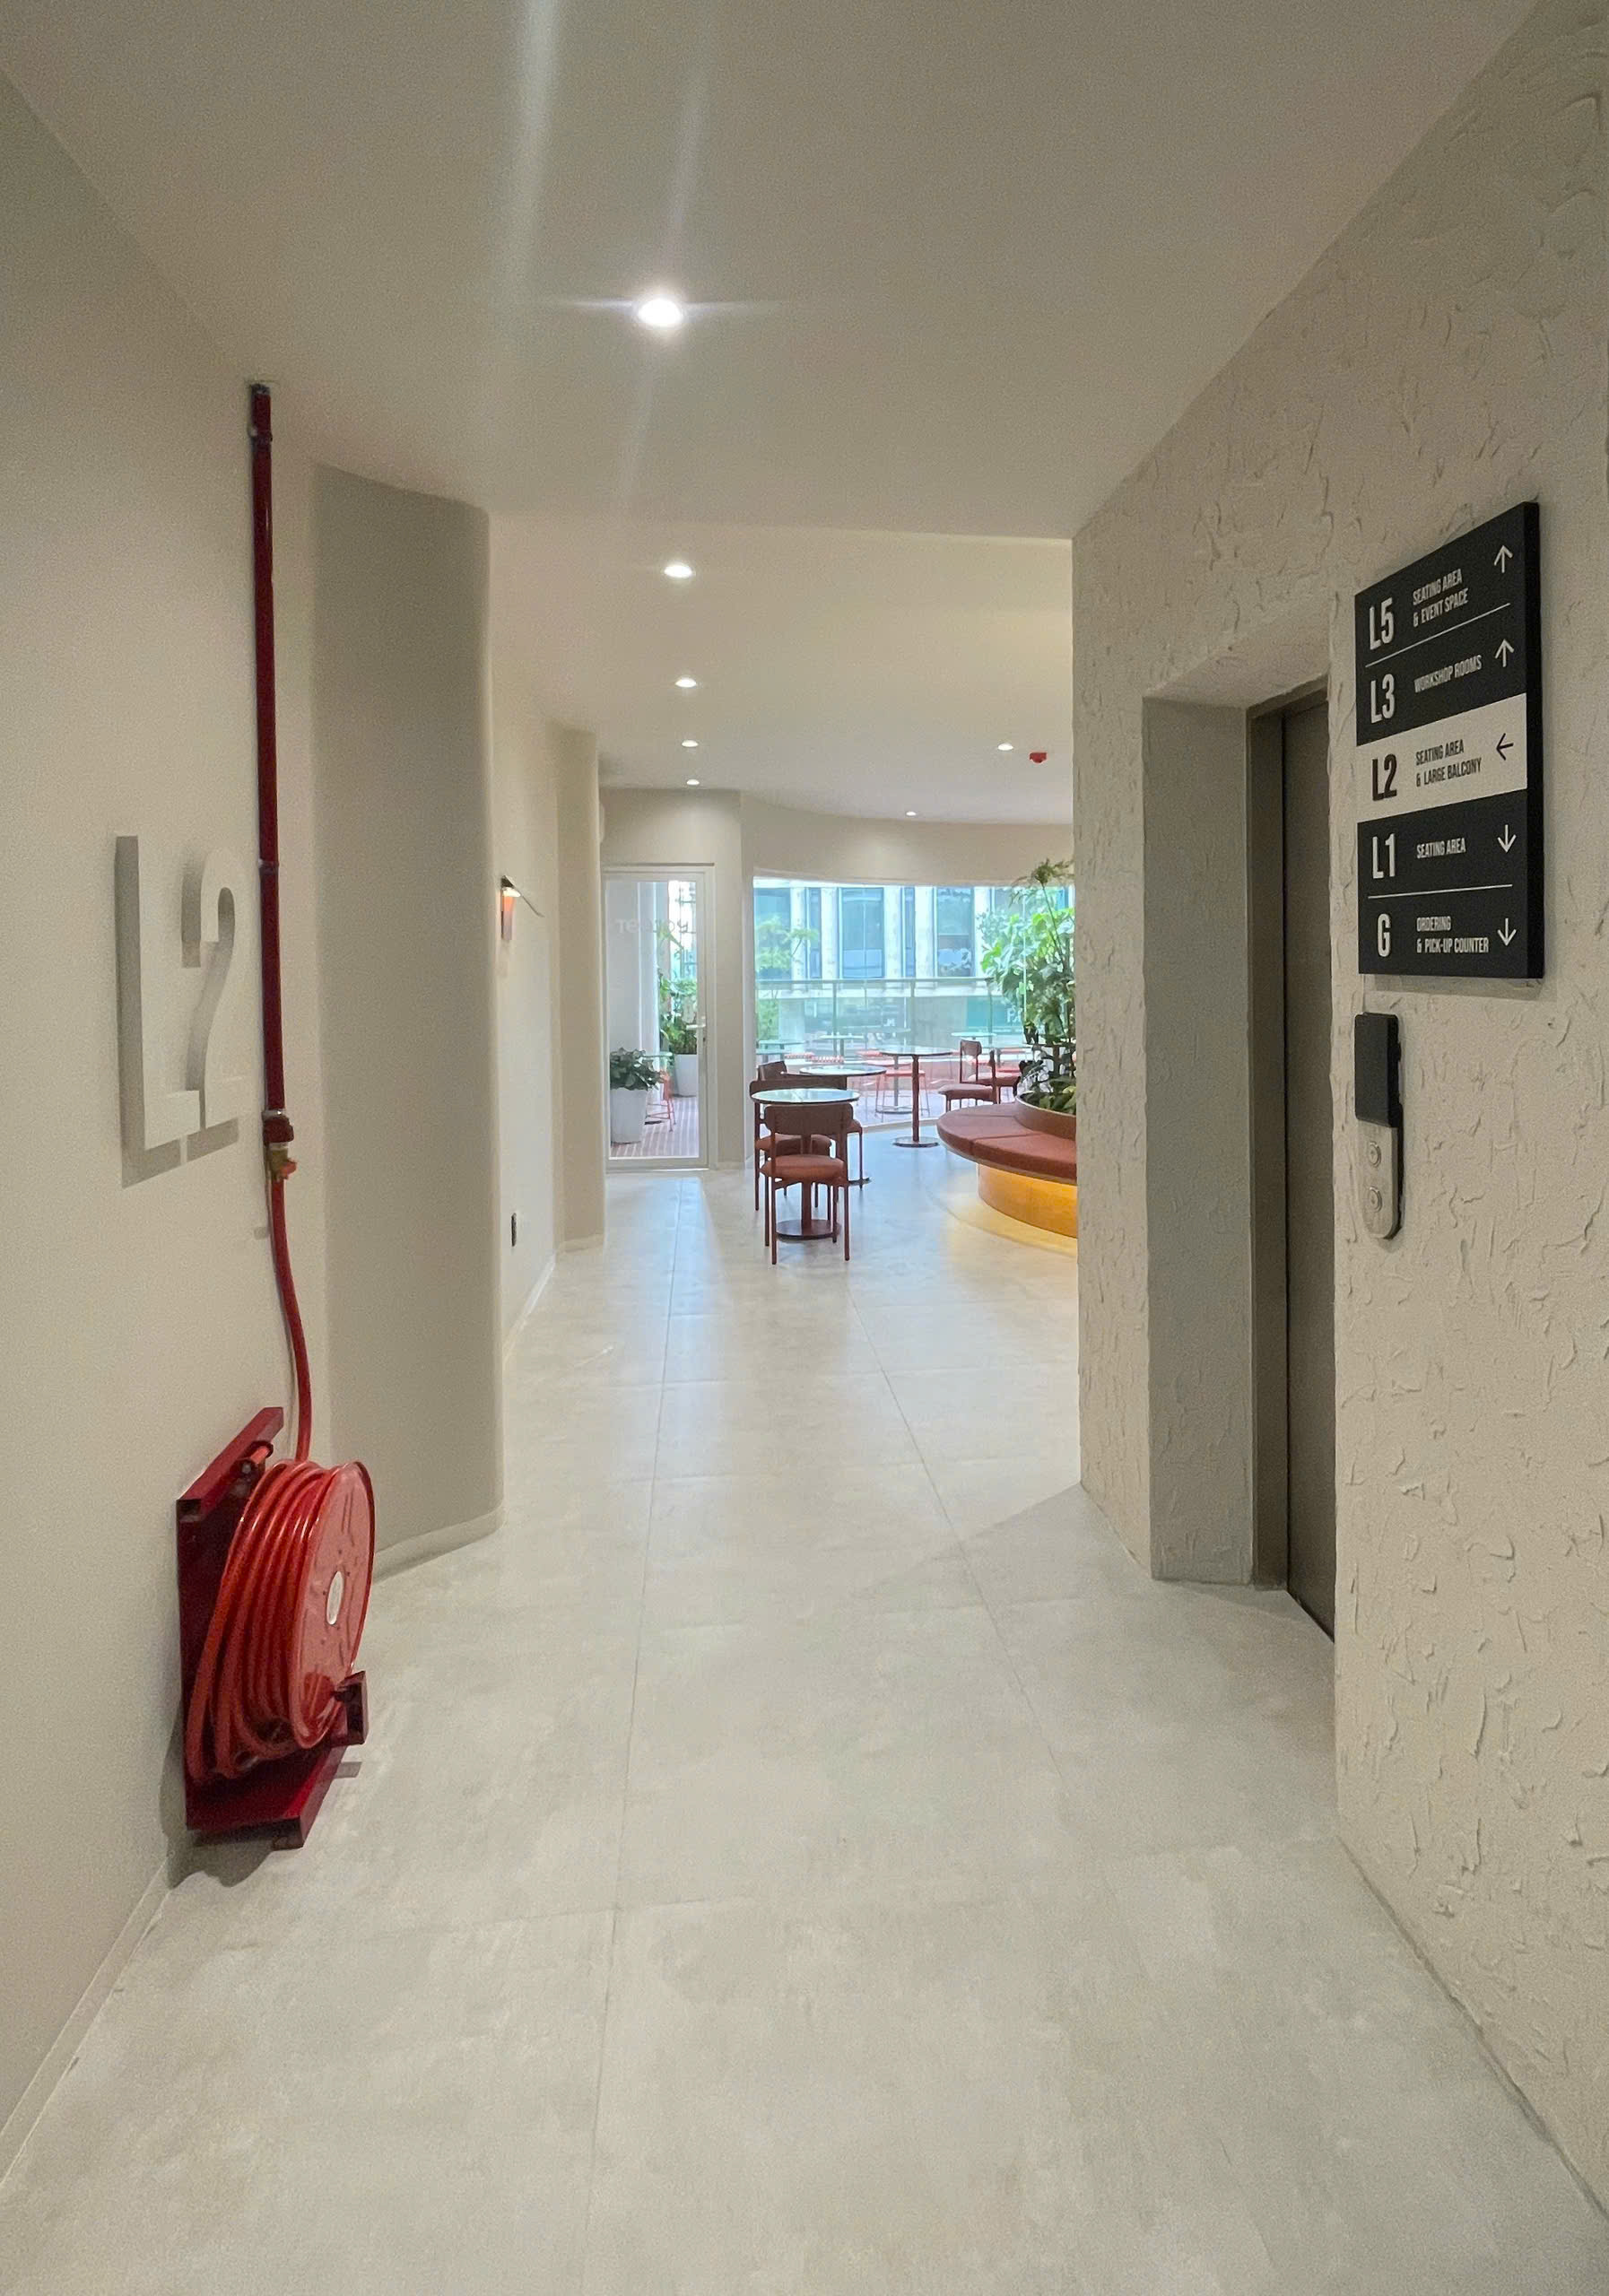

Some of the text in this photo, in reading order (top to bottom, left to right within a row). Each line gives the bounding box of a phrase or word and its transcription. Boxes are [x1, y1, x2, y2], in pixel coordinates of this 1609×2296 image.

[1413, 568, 1463, 605] SEATING AREA
[1369, 596, 1394, 650] L5
[1413, 587, 1468, 628] & EVENT SPACE
[1413, 654, 1483, 693] WORKSHOP ROOMS
[1370, 673, 1395, 724] L3
[1415, 738, 1465, 766] SEATING AREA
[1415, 757, 1482, 787] & LARGE BALCONY
[1371, 753, 1397, 802] L2
[1372, 832, 1396, 879] L1
[1416, 837, 1466, 859] SEATING AREA
[1377, 913, 1391, 958] G
[1416, 916, 1451, 932] ORDERING
[1416, 937, 1489, 953] & PICK-UP COUNTER
[115, 835, 244, 1189] L2
